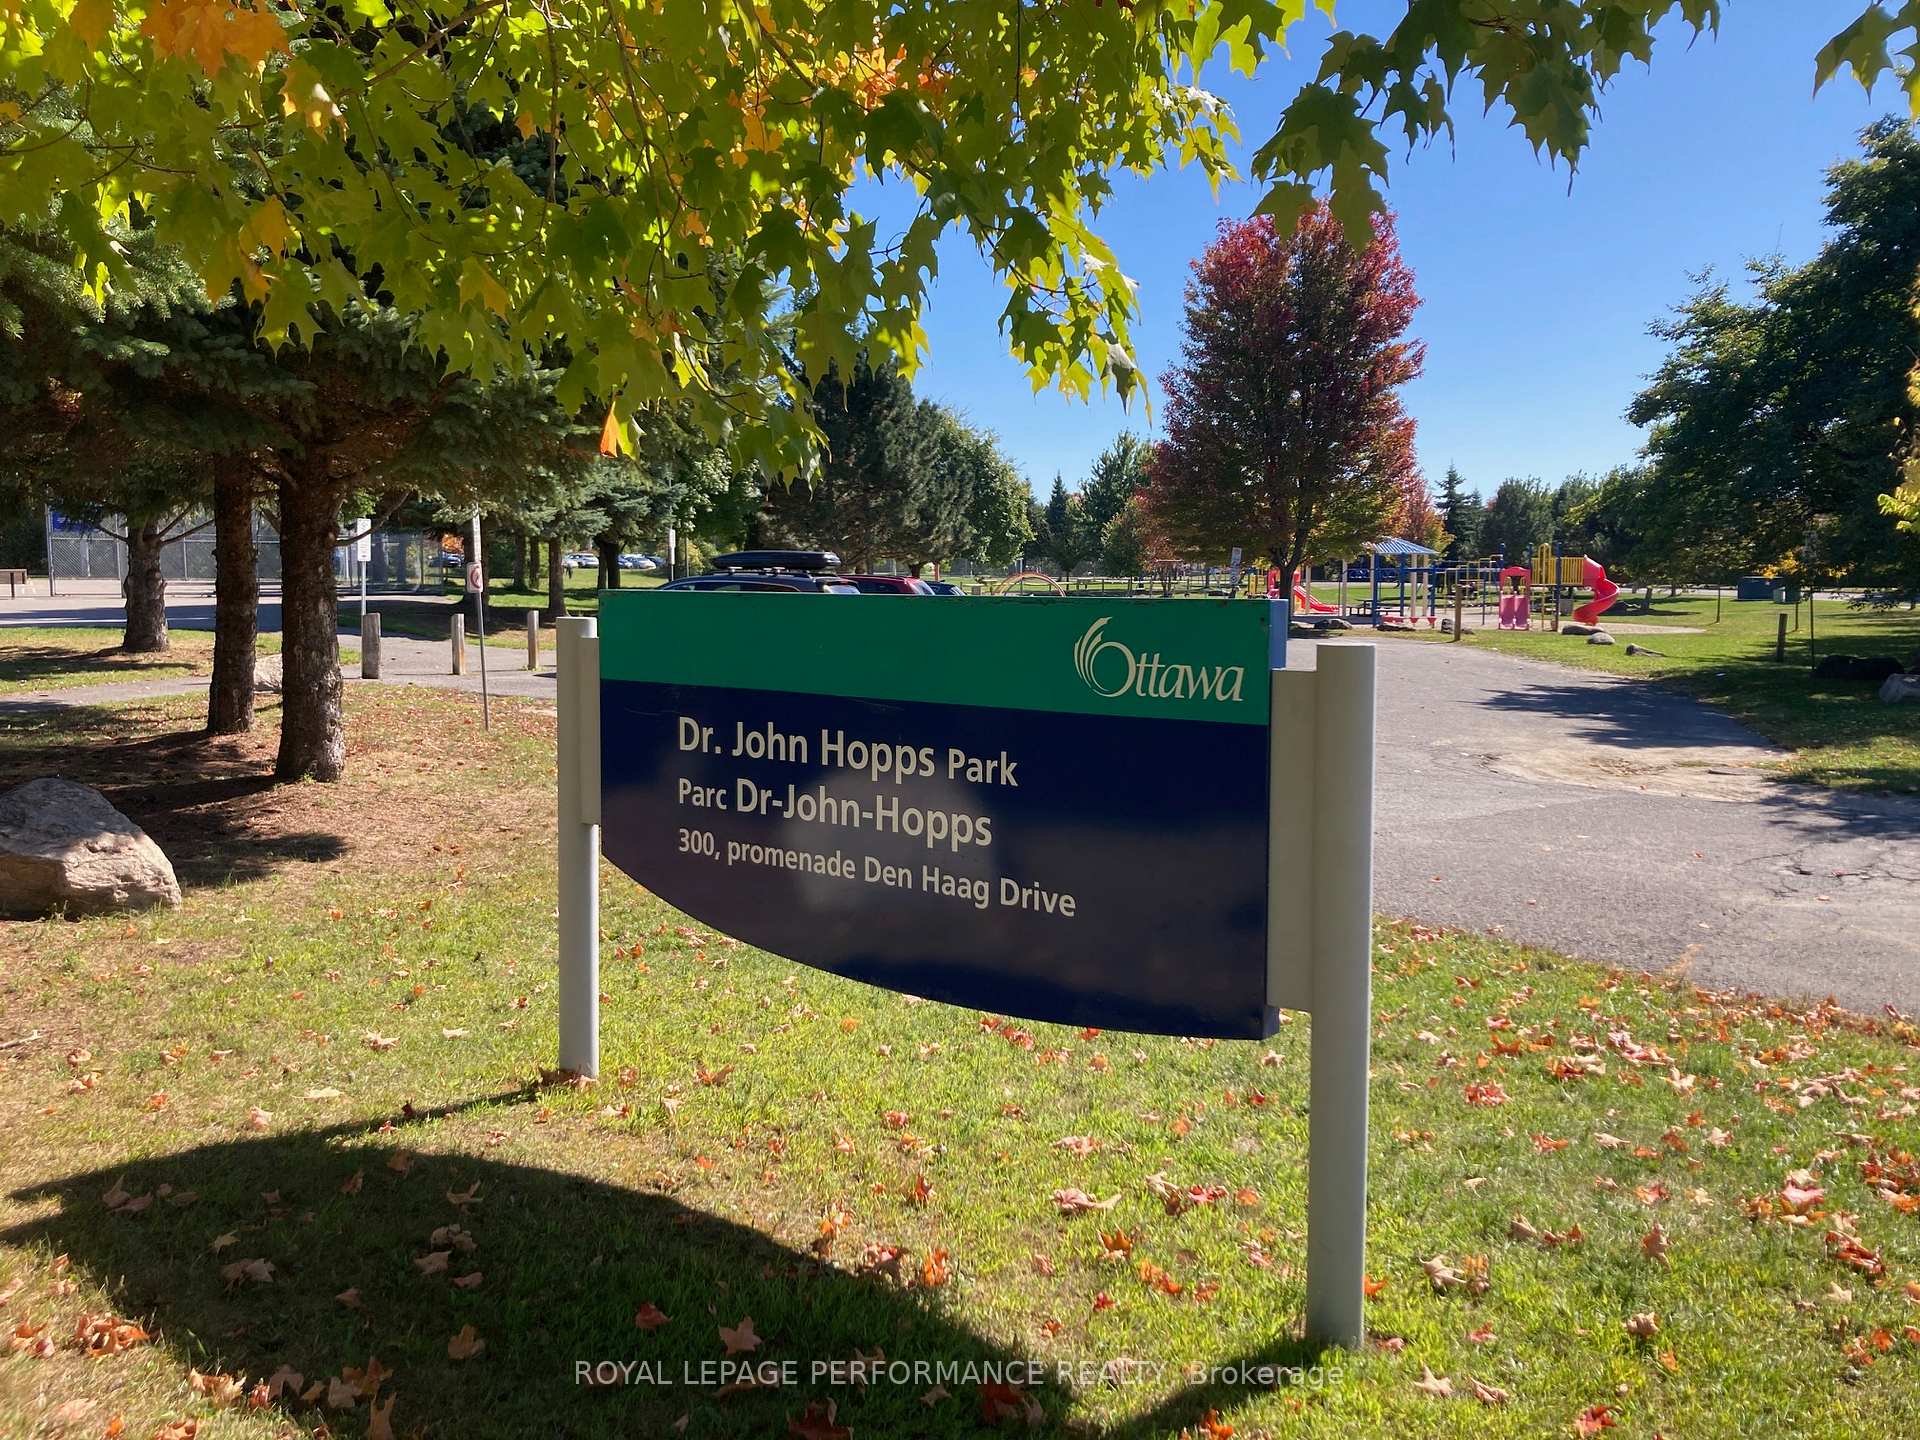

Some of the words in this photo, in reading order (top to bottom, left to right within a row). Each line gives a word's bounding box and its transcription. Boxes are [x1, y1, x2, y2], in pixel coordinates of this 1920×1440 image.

[1074, 617, 1244, 701] Ottawa
[679, 716, 721, 754] Dr.
[732, 721, 808, 763] John
[821, 729, 936, 785] Hopps
[948, 748, 1018, 787] Park
[679, 777, 727, 812] Parc
[737, 778, 992, 853] Dr-John-Hopps
[679, 828, 720, 860] 300,
[728, 841, 856, 880] promenade
[864, 855, 912, 889] Den
[922, 865, 989, 909] Haag
[1000, 877, 1076, 917] Drive
